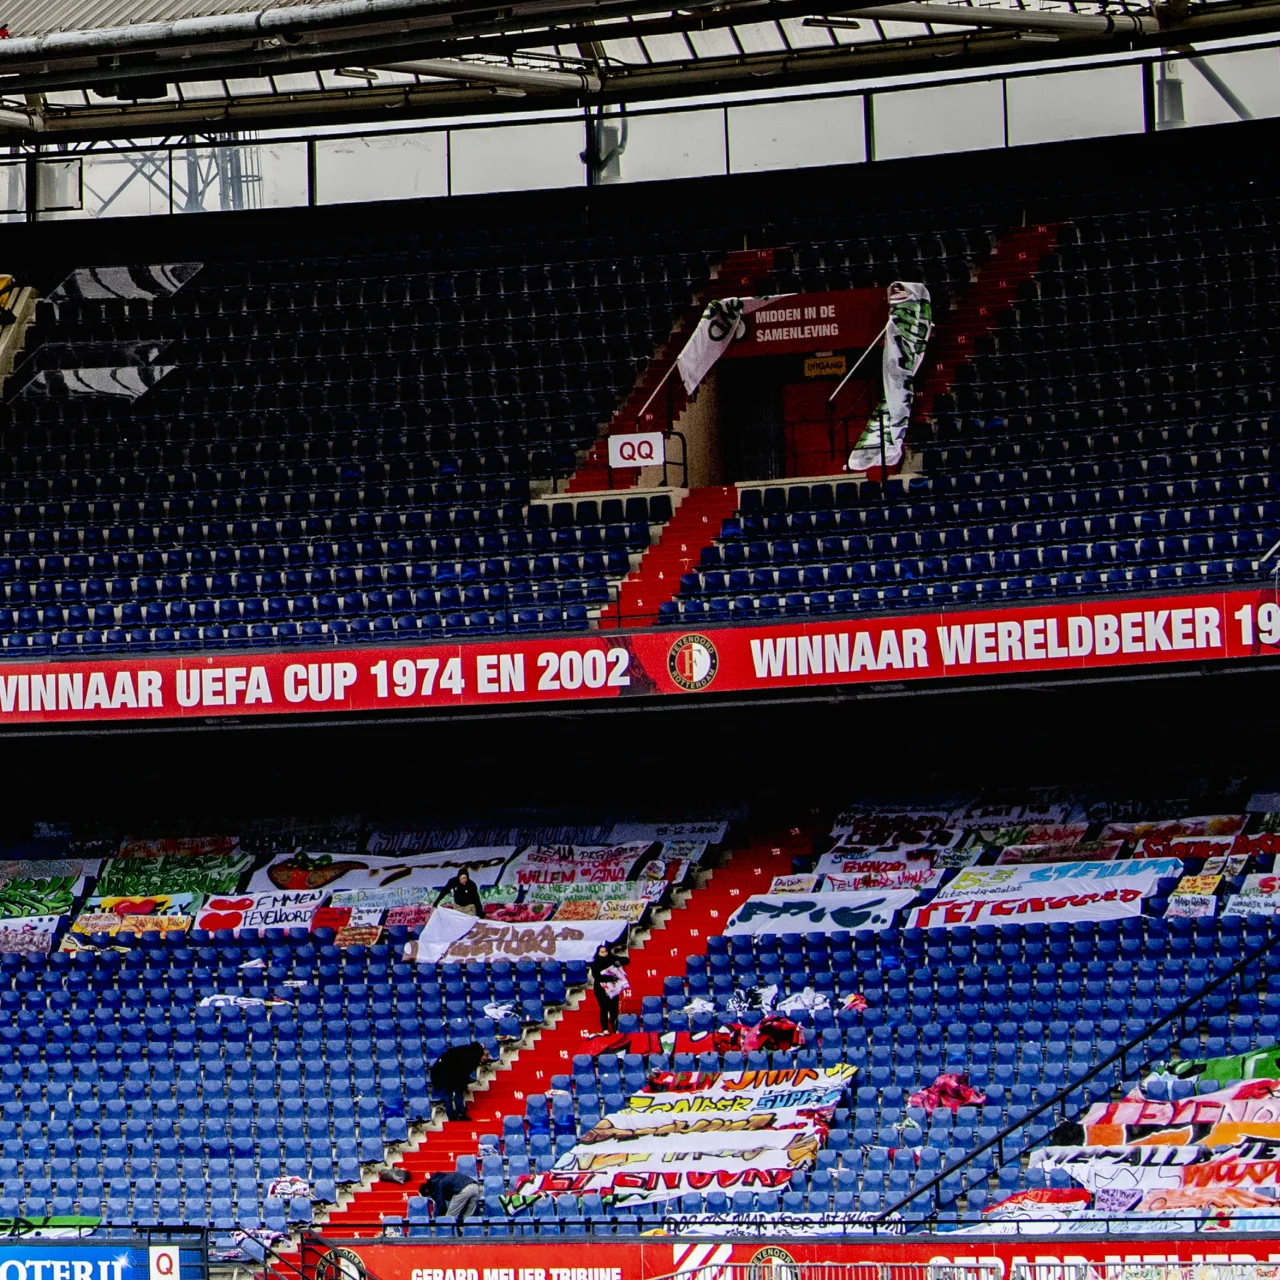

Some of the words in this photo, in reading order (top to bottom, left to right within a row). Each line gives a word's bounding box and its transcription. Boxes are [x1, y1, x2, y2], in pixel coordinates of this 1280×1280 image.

[755, 307, 797, 325] MIDDEN
[801, 306, 816, 321] IN
[820, 305, 837, 320] DE
[756, 323, 839, 343] SAMENLEVING
[618, 439, 655, 462] QQ
[670, 635, 717, 664] FEYENOORD
[749, 628, 930, 680] WINNAAR
[936, 606, 1223, 667] WERELDBEKER
[175, 665, 279, 708] UEFA
[282, 661, 356, 703] CUP
[369, 656, 466, 699] 1974
[476, 652, 525, 693] EN
[537, 648, 632, 691] 2002
[670, 664, 717, 692] ROTTERDAM
[242, 908, 313, 928] FEYENOORD
[157, 1252, 175, 1277] Q
